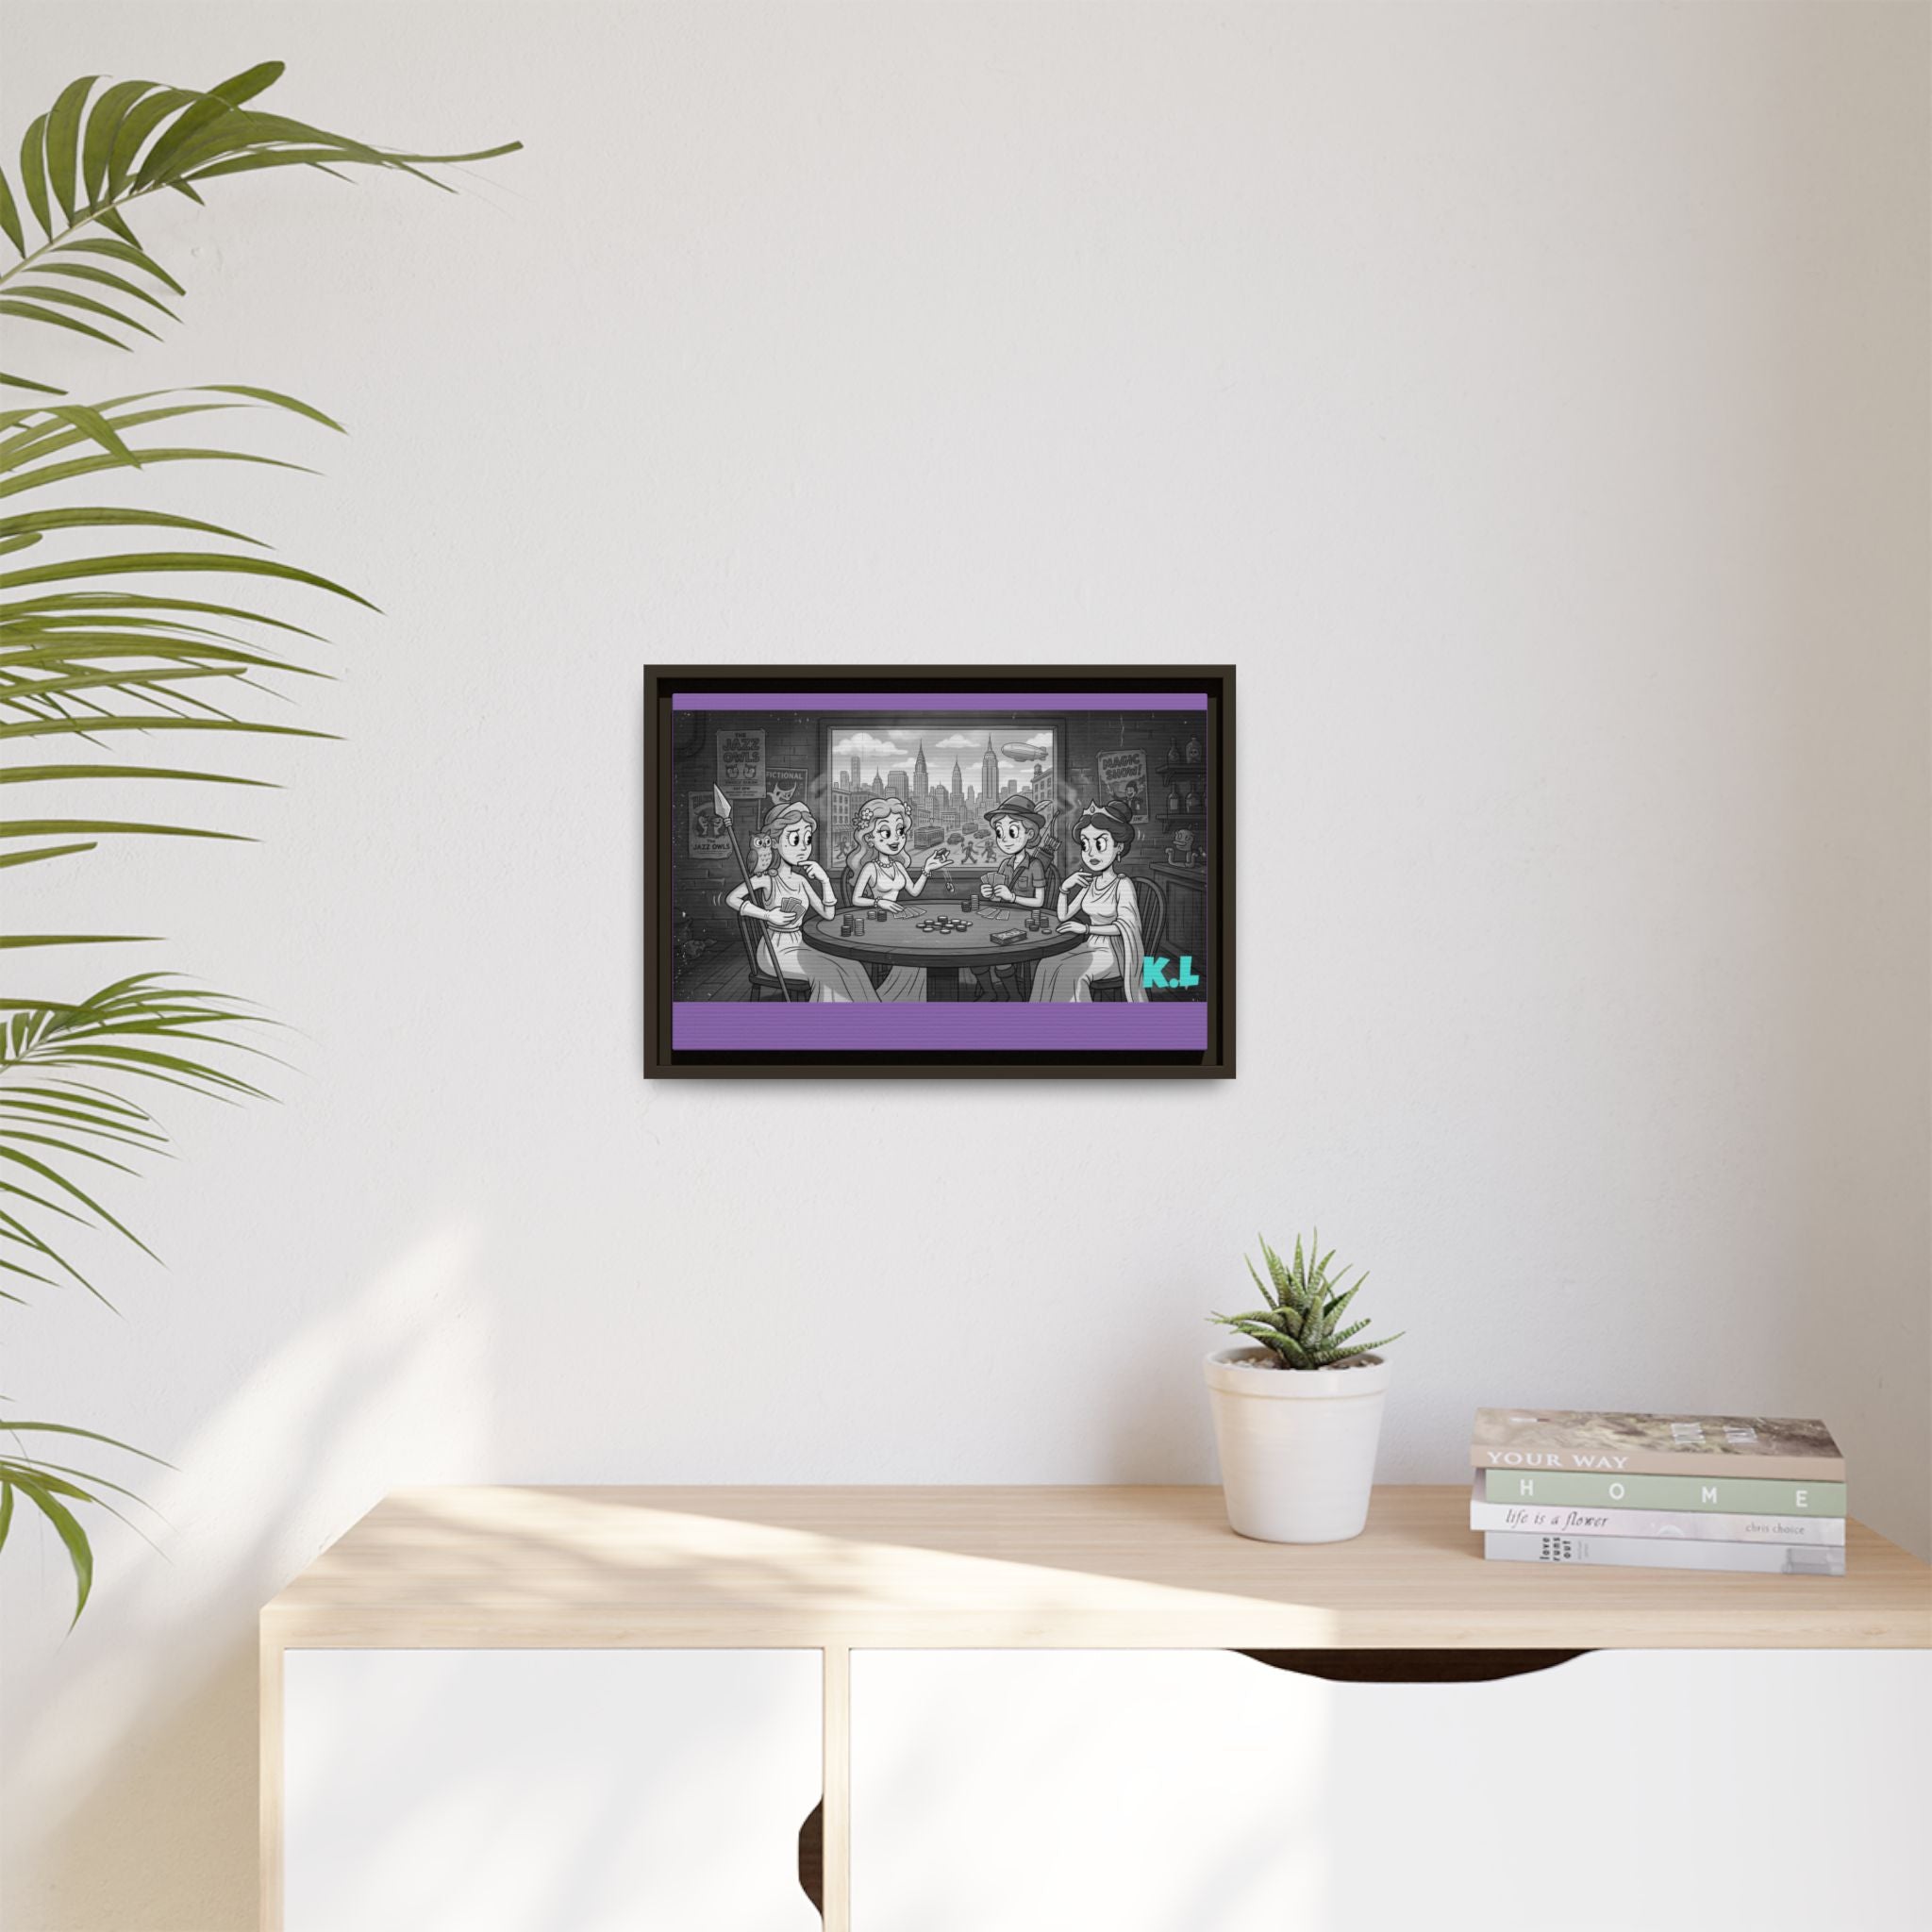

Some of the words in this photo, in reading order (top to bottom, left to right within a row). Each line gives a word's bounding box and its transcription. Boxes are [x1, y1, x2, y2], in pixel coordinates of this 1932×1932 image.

[723, 738, 760, 751] JAZZ
[723, 751, 760, 763] OWLS
[1102, 753, 1141, 771] MAGIC
[766, 771, 804, 780] FICTIONAL
[1105, 764, 1142, 780] SHOW!
[1142, 956, 1200, 989] K.L
[1487, 1451, 1563, 1467] YOUR
[1573, 1454, 1629, 1470] WAY
[1505, 1508, 1529, 1528] life
[1534, 1510, 1547, 1526] is
[1550, 1515, 1559, 1525] a
[1561, 1510, 1609, 1531] flower
[1744, 1521, 1770, 1534] chris
[1772, 1522, 1806, 1535] choice
[1540, 1537, 1550, 1560] love
[1562, 1541, 1572, 1559] out
